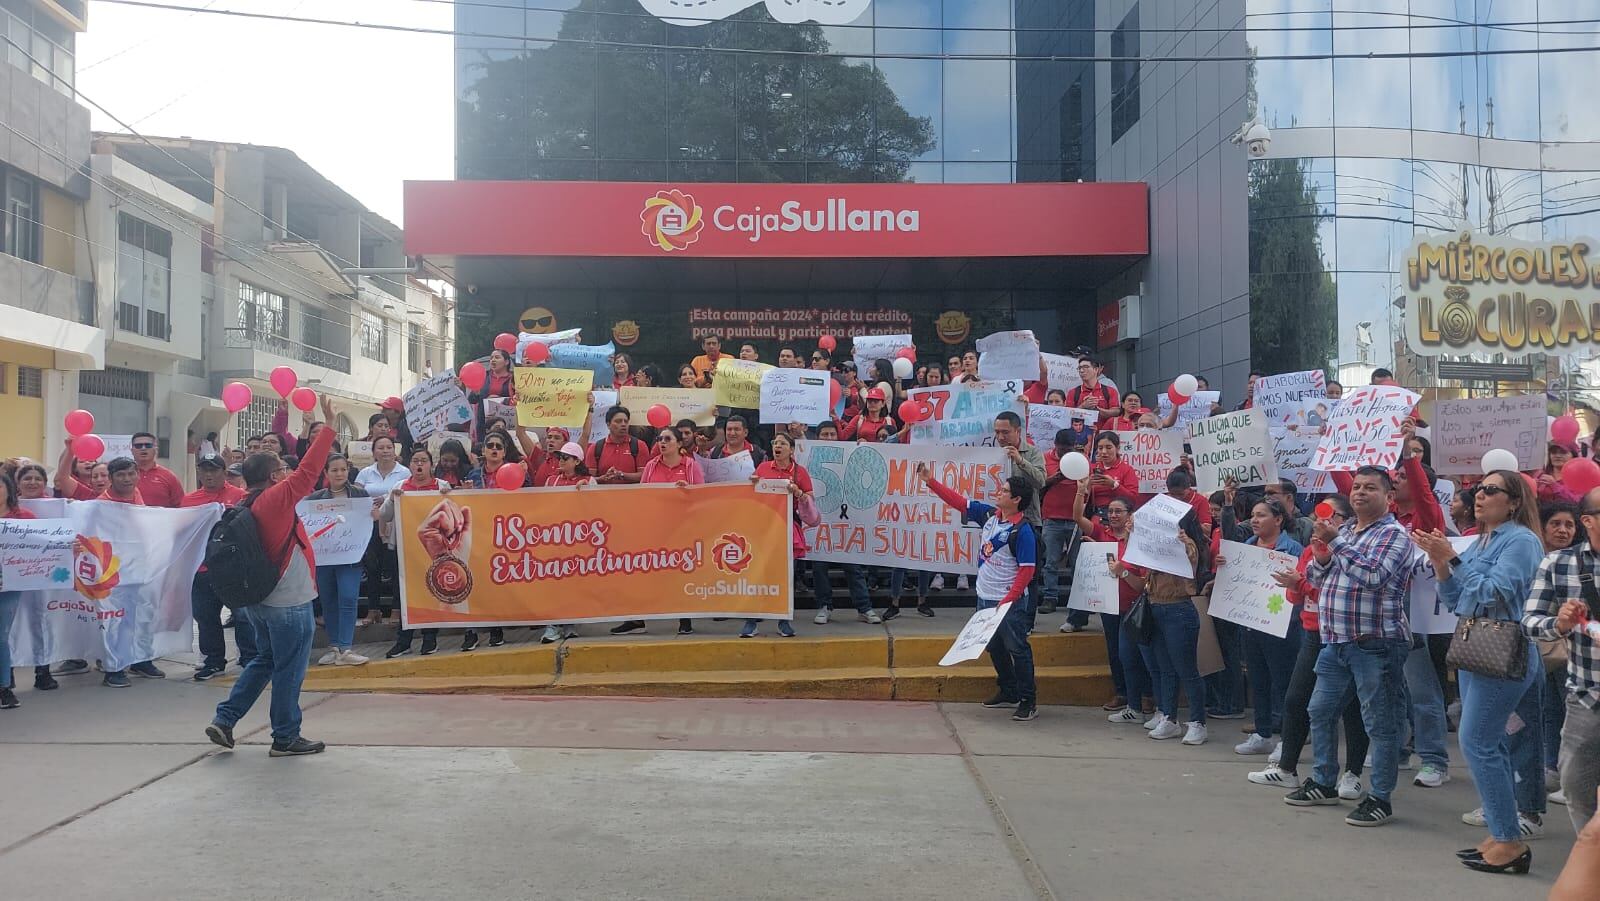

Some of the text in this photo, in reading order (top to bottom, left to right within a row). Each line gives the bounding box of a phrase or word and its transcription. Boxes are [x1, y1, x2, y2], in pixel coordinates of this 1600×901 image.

[713, 198, 920, 242] CajaSullana
[690, 308, 721, 322] ¡Esta
[723, 308, 780, 323] campaña
[821, 308, 848, 324] pide
[850, 309, 863, 321] tu
[865, 308, 912, 323] crédito,
[726, 325, 777, 339] puntual
[778, 328, 786, 341] y
[847, 325, 866, 337] del
[913, 390, 951, 421] 37
[1207, 417, 1230, 434] LUCHA
[1231, 414, 1252, 429] QUE
[1132, 433, 1161, 452] 1900
[1196, 453, 1209, 467] LA
[1232, 448, 1247, 461] ES
[1249, 446, 1265, 457] DE
[808, 445, 889, 515] 50
[877, 501, 953, 526] NO VALE
[494, 515, 609, 552] ¡Somos
[871, 525, 982, 568] SULLAN
[492, 541, 703, 584] Extraordinarios!
[683, 578, 780, 600] CajaSullana
